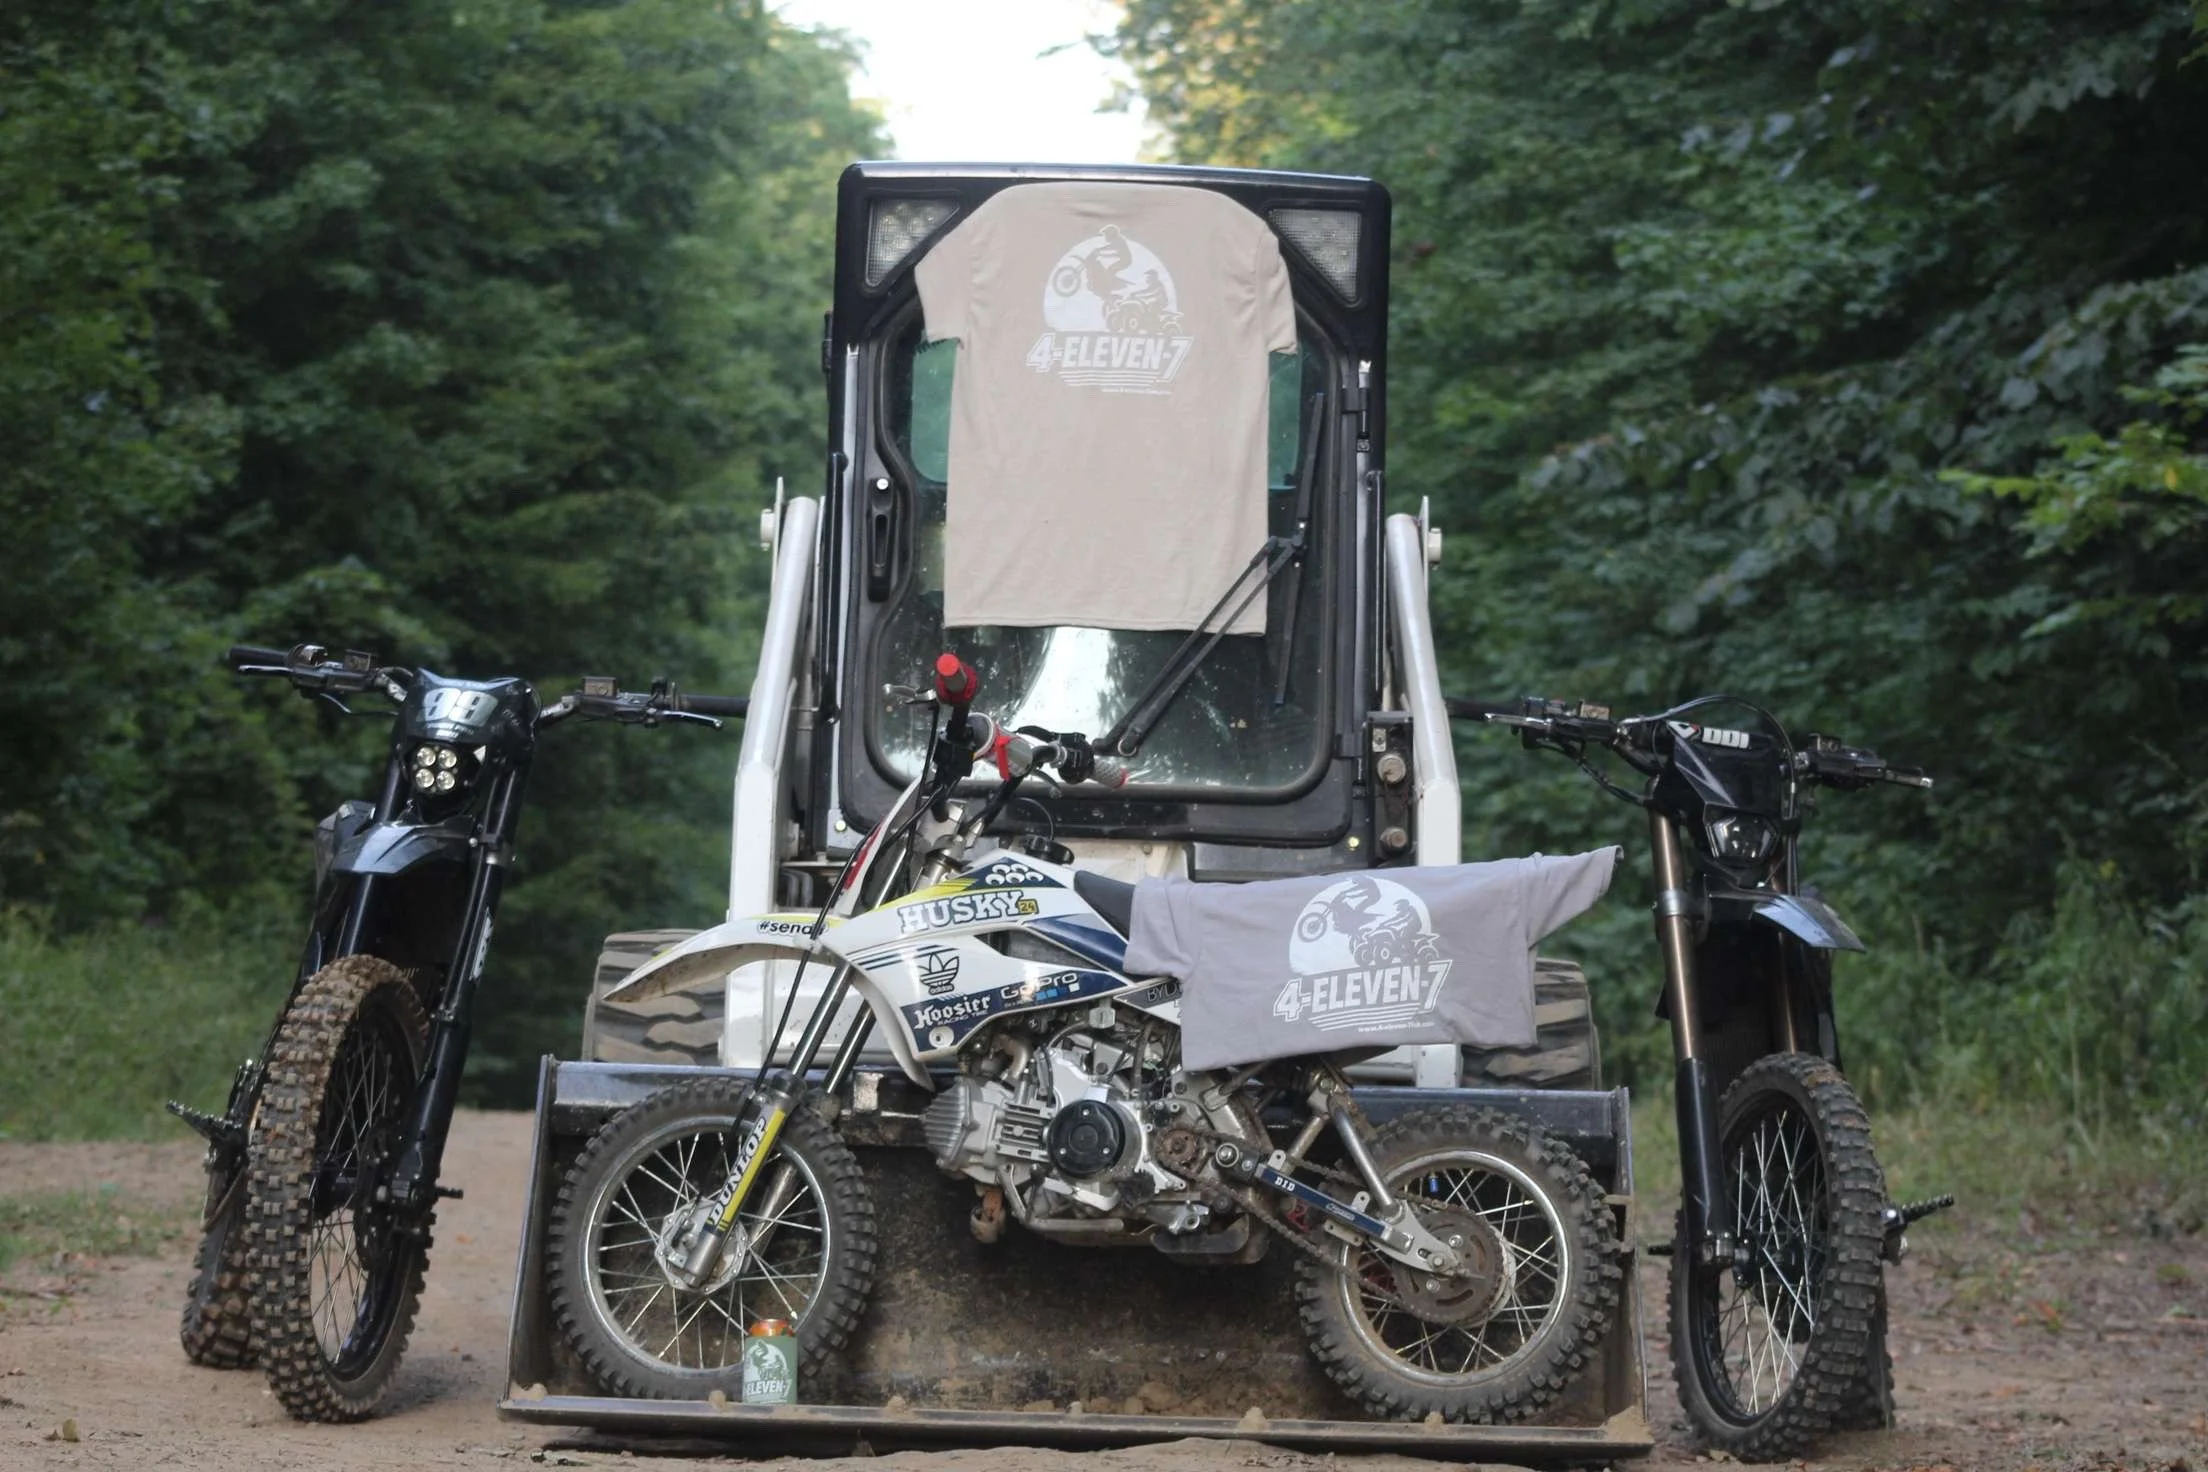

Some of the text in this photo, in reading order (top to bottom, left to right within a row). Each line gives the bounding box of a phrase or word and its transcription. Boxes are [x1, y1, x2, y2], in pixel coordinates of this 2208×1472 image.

[1026, 332, 1195, 384] 4-ELEVEN-7
[898, 889, 1022, 934] HUSKY
[1000, 973, 1077, 999] GoPro
[1273, 959, 1453, 1022] 4-ELEVEN-7
[913, 994, 991, 1029] Hoosier
[709, 1116, 766, 1226] DUNLOP
[1274, 1175, 1296, 1192] DID
